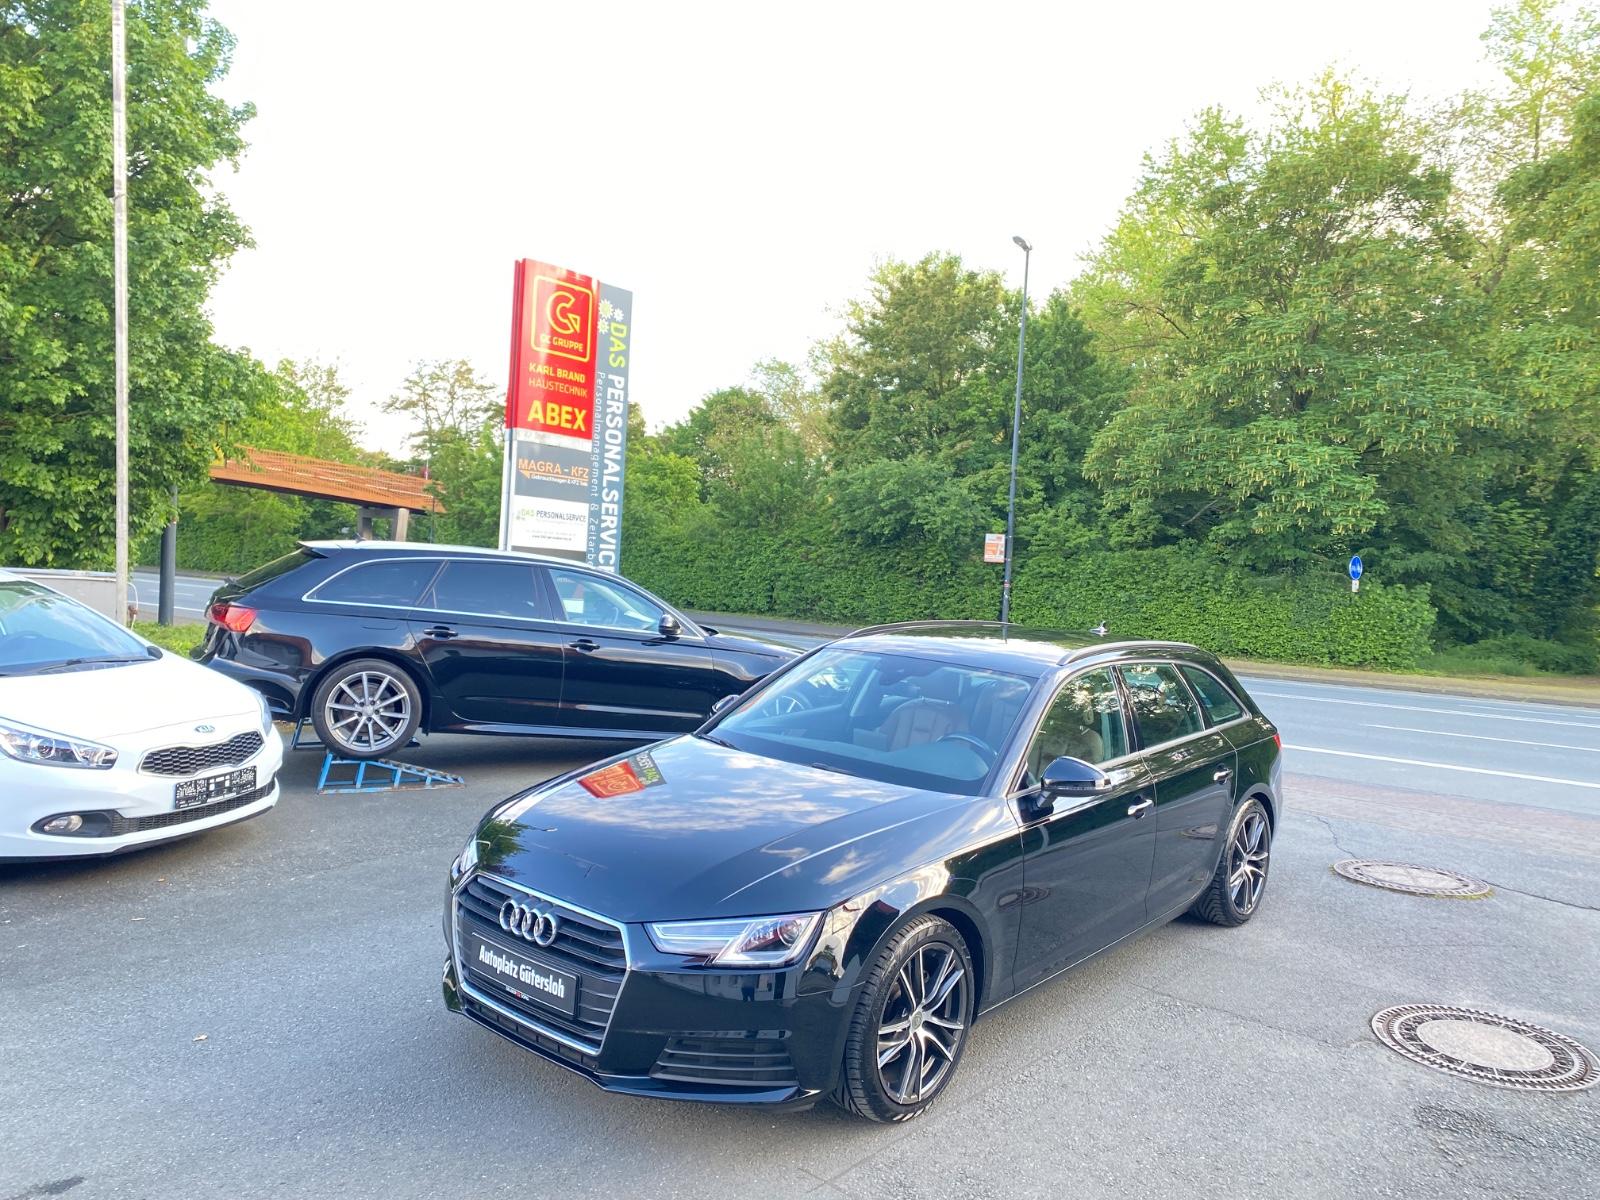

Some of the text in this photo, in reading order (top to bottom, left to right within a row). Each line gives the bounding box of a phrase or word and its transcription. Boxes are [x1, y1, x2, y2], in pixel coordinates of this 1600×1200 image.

[552, 335, 584, 352] GRUPPE
[608, 321, 627, 368] DAS
[529, 362, 586, 384] KARL BRAND
[528, 377, 588, 398] HAUSTECHNIK
[527, 399, 587, 432] ABEX
[590, 371, 606, 497] Personalmanagement
[518, 457, 562, 475] MAGRA
[570, 466, 589, 479] KFZ
[536, 510, 587, 523] PERSONALSERVICE
[479, 945, 518, 979] Autoplatz
[519, 965, 565, 998] Gütersloh
